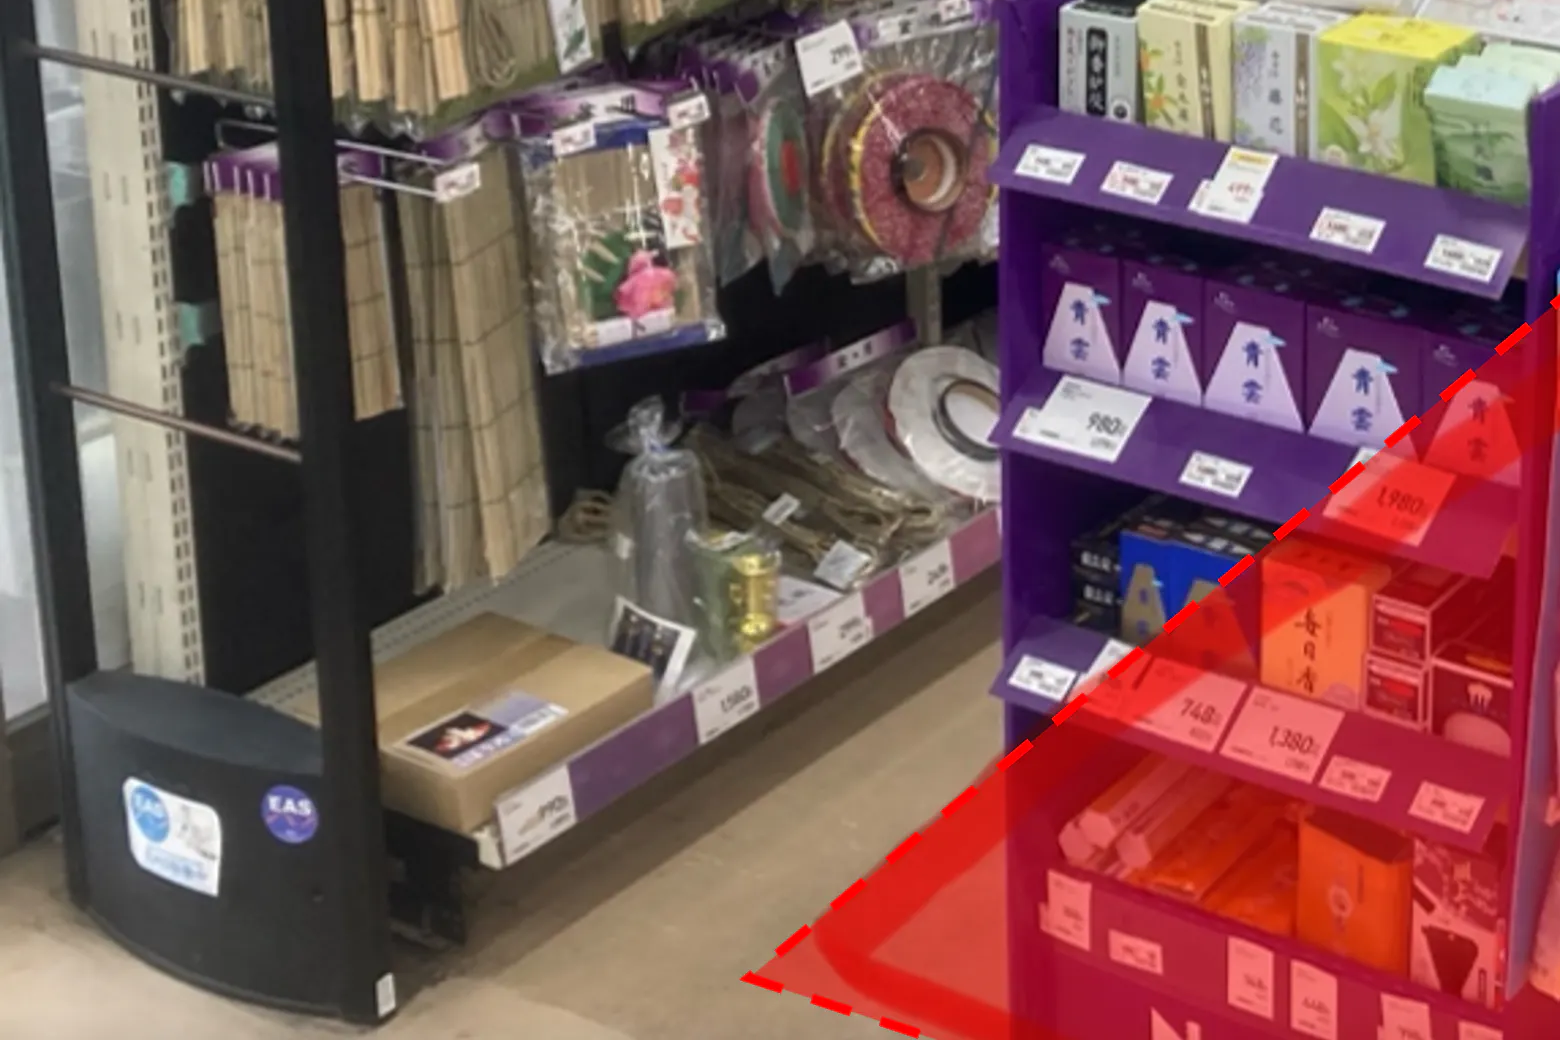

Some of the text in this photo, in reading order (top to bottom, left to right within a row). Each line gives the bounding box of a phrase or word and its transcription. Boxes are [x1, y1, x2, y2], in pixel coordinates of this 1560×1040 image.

[1070, 299, 1091, 361] 青雲
[1152, 317, 1171, 381] 青雲
[1243, 339, 1264, 404] 青雲
[1352, 366, 1375, 433] 青雲
[1087, 412, 1121, 435] 980
[1466, 396, 1490, 461] 青雲
[1268, 726, 1314, 753] 1,380
[268, 795, 313, 815] EAS
